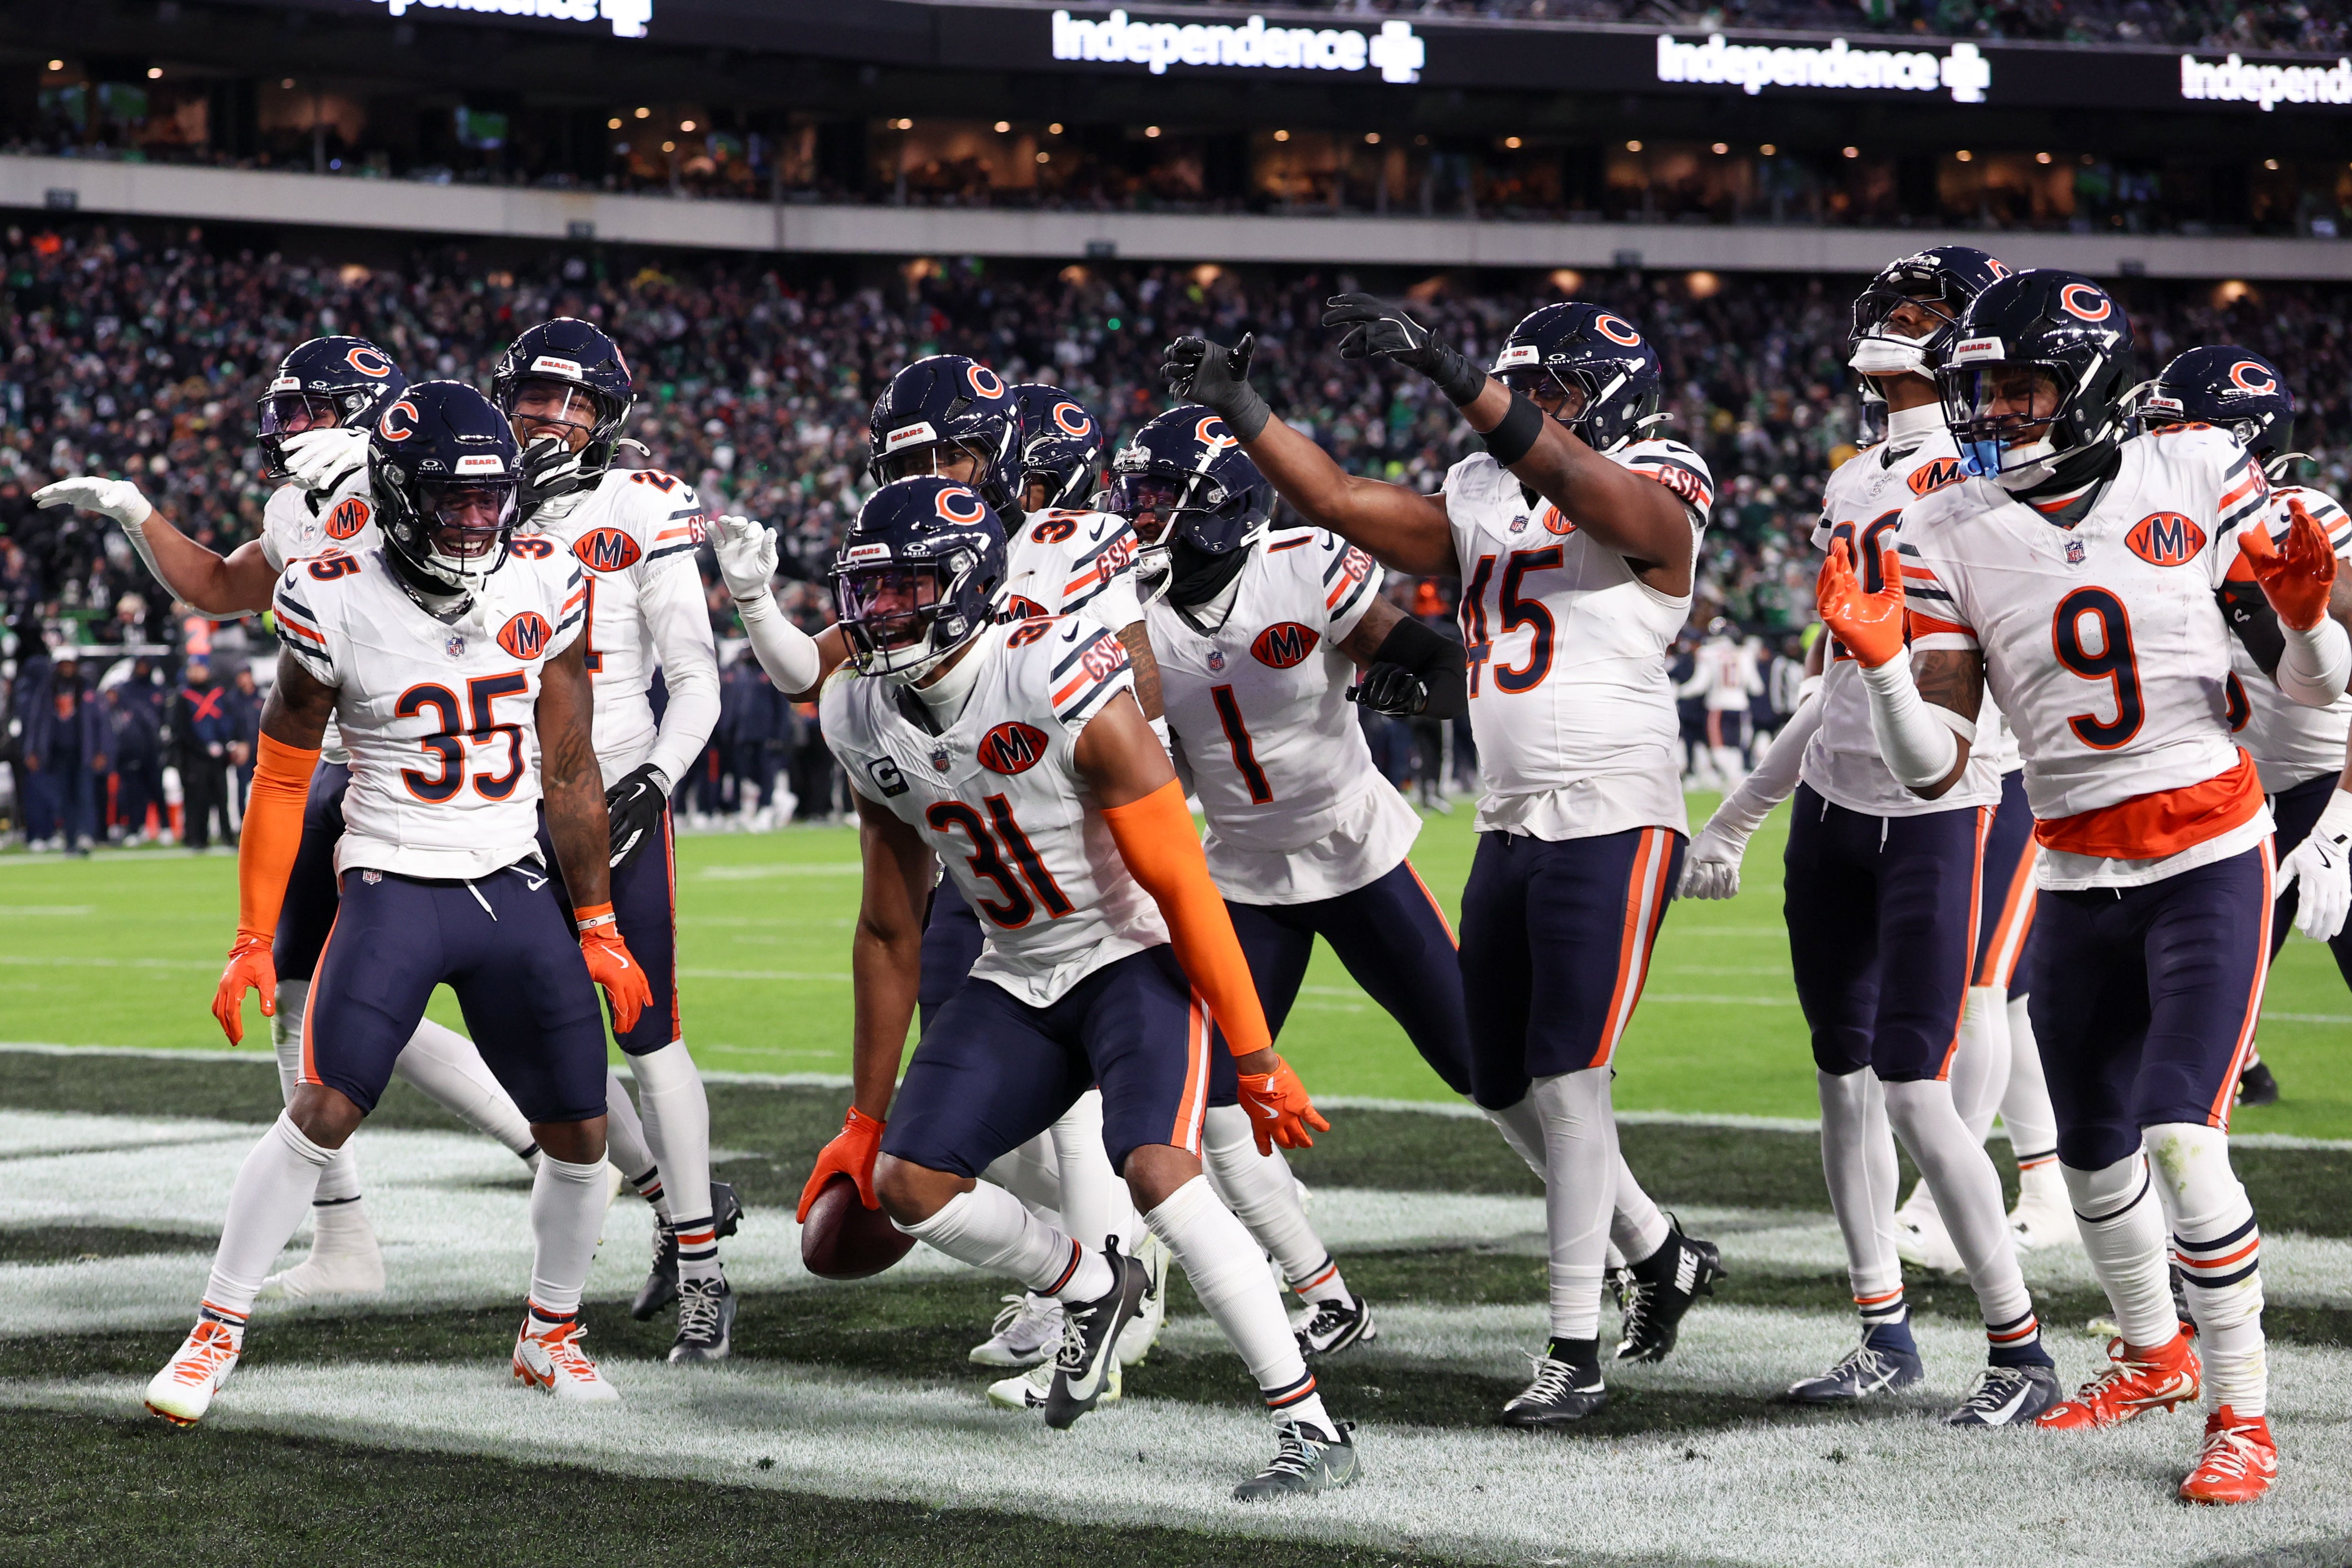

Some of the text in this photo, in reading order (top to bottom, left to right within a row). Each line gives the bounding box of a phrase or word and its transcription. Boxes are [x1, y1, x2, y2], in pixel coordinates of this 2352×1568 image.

[1052, 9, 1367, 75] Independence
[1657, 32, 1940, 96] Independence
[1501, 349, 1528, 359] BARS
[1959, 343, 1992, 353] BEARS
[541, 360, 575, 372] BEARS
[2150, 399, 2176, 408] BEARS
[890, 427, 925, 443] BEARS
[1658, 464, 1702, 505] GSH
[1916, 461, 1962, 491] VM
[688, 514, 705, 544] GS
[2136, 517, 2199, 561] VMH
[582, 530, 634, 568] VMH
[851, 547, 881, 556] BEARS
[2067, 551, 2083, 562] NFL
[505, 615, 546, 656] VMH
[1461, 544, 1563, 699] 45
[449, 645, 463, 655] NFL
[1080, 634, 1124, 683] GSH
[1258, 625, 1313, 665] VMH
[1209, 659, 1223, 670] NFL
[2052, 585, 2145, 750] 9
[395, 669, 528, 804] 35
[1210, 684, 1274, 805] 1
[935, 760, 948, 772] NFL
[365, 871, 380, 881] NFL
[926, 792, 1076, 930] 31
[1674, 1245, 1700, 1295] NIKE
[2041, 1406, 2070, 1421] 9
